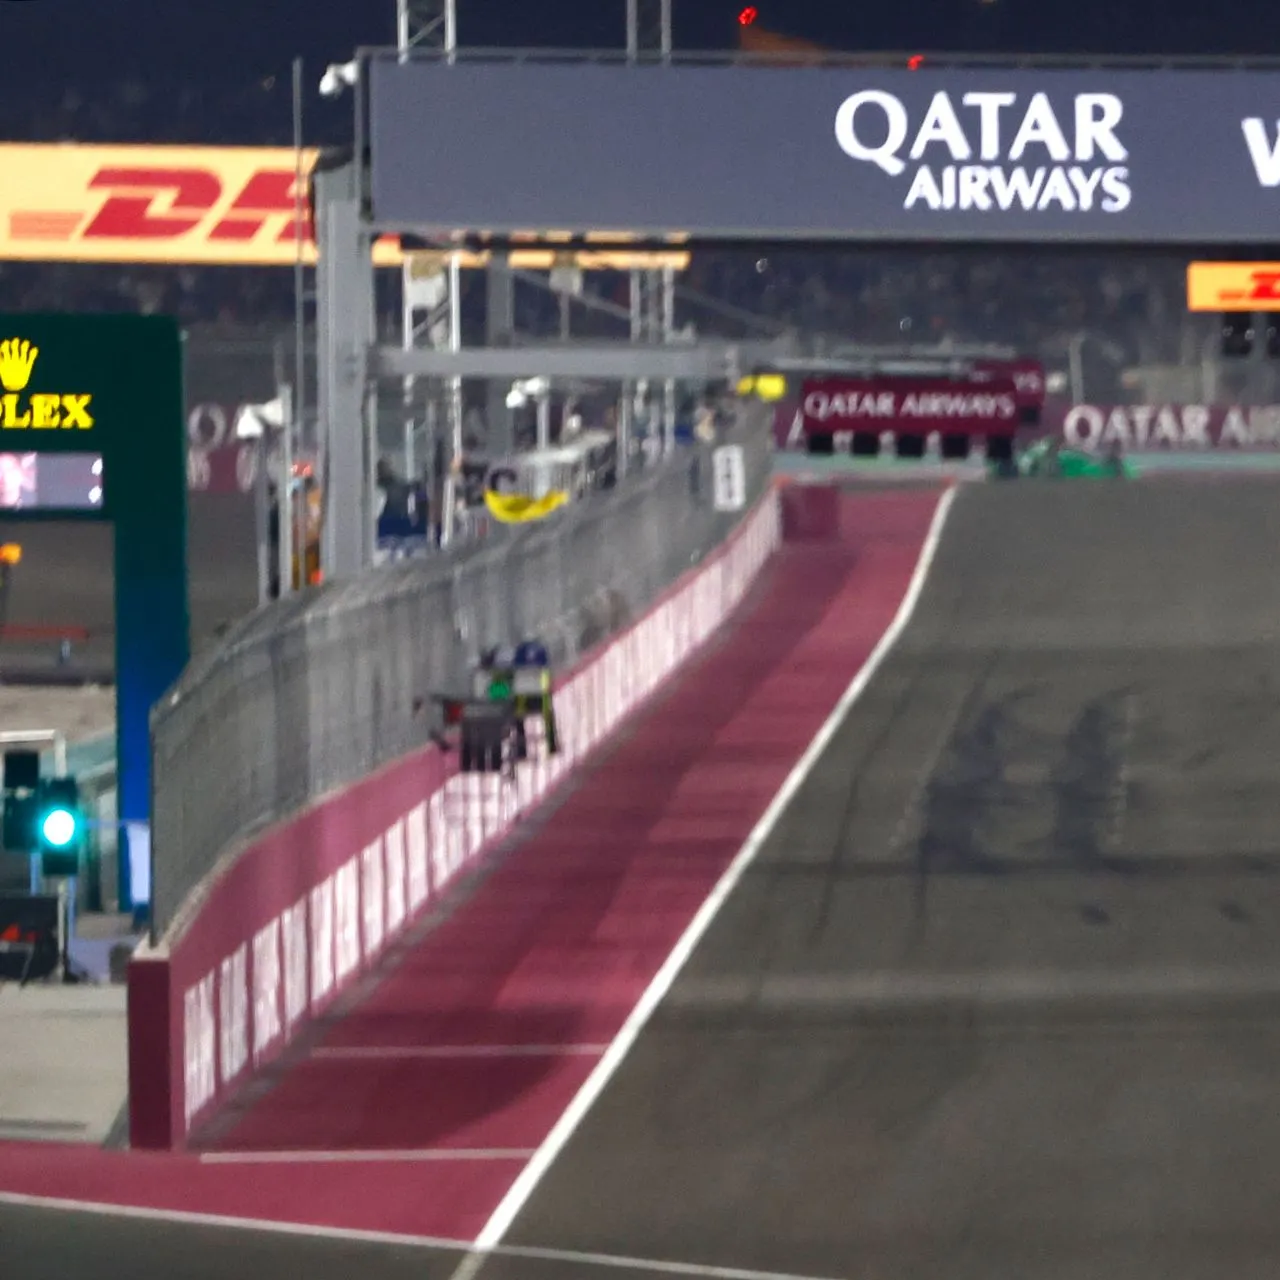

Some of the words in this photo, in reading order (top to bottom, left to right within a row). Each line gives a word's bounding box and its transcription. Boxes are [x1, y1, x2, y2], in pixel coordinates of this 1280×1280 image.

[834, 90, 1128, 176] QATAR
[83, 166, 312, 242] DH
[904, 164, 1132, 212] AIRWAYS
[0, 393, 95, 429] LEX
[804, 391, 894, 421] QATAR
[900, 391, 1015, 419] AIRWAYS
